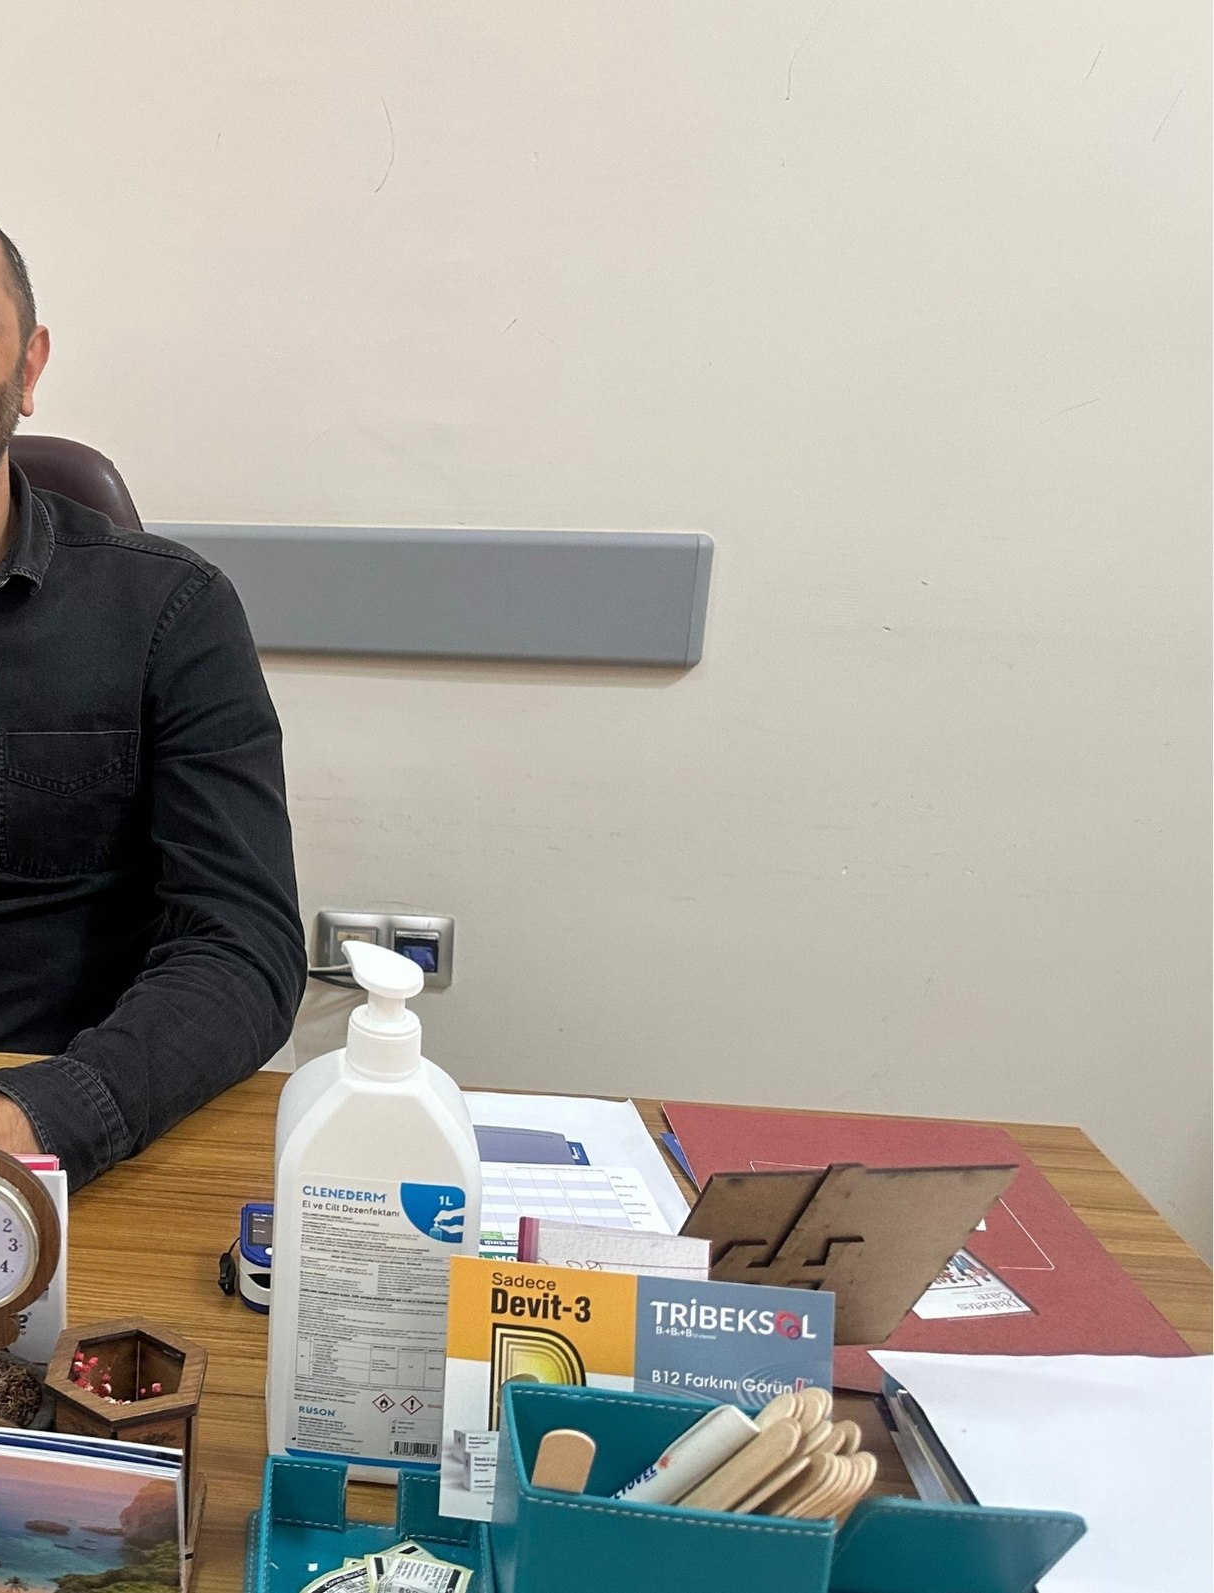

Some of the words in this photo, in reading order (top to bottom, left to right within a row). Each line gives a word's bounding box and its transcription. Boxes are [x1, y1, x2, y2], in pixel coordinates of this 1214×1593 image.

[302, 1185, 386, 1204] CLENEDERM
[438, 1195, 454, 1206] 1L
[302, 1200, 311, 1209] El
[313, 1202, 323, 1210] ve
[325, 1203, 340, 1212] Cilt
[342, 1204, 400, 1217] Dezenfektanı
[3, 1218, 13, 1233] 2
[8, 1238, 18, 1252] 3
[0, 1260, 9, 1273] 4
[492, 1272, 557, 1290] Sadece
[974, 1291, 1012, 1301] Care
[490, 1288, 591, 1323] Devit-3
[956, 1299, 1022, 1312] Diabetes
[650, 1298, 817, 1340] TRİBEKSOL
[652, 1369, 680, 1385] B12
[685, 1373, 737, 1390] Farkını
[299, 1405, 335, 1417] RUSON
